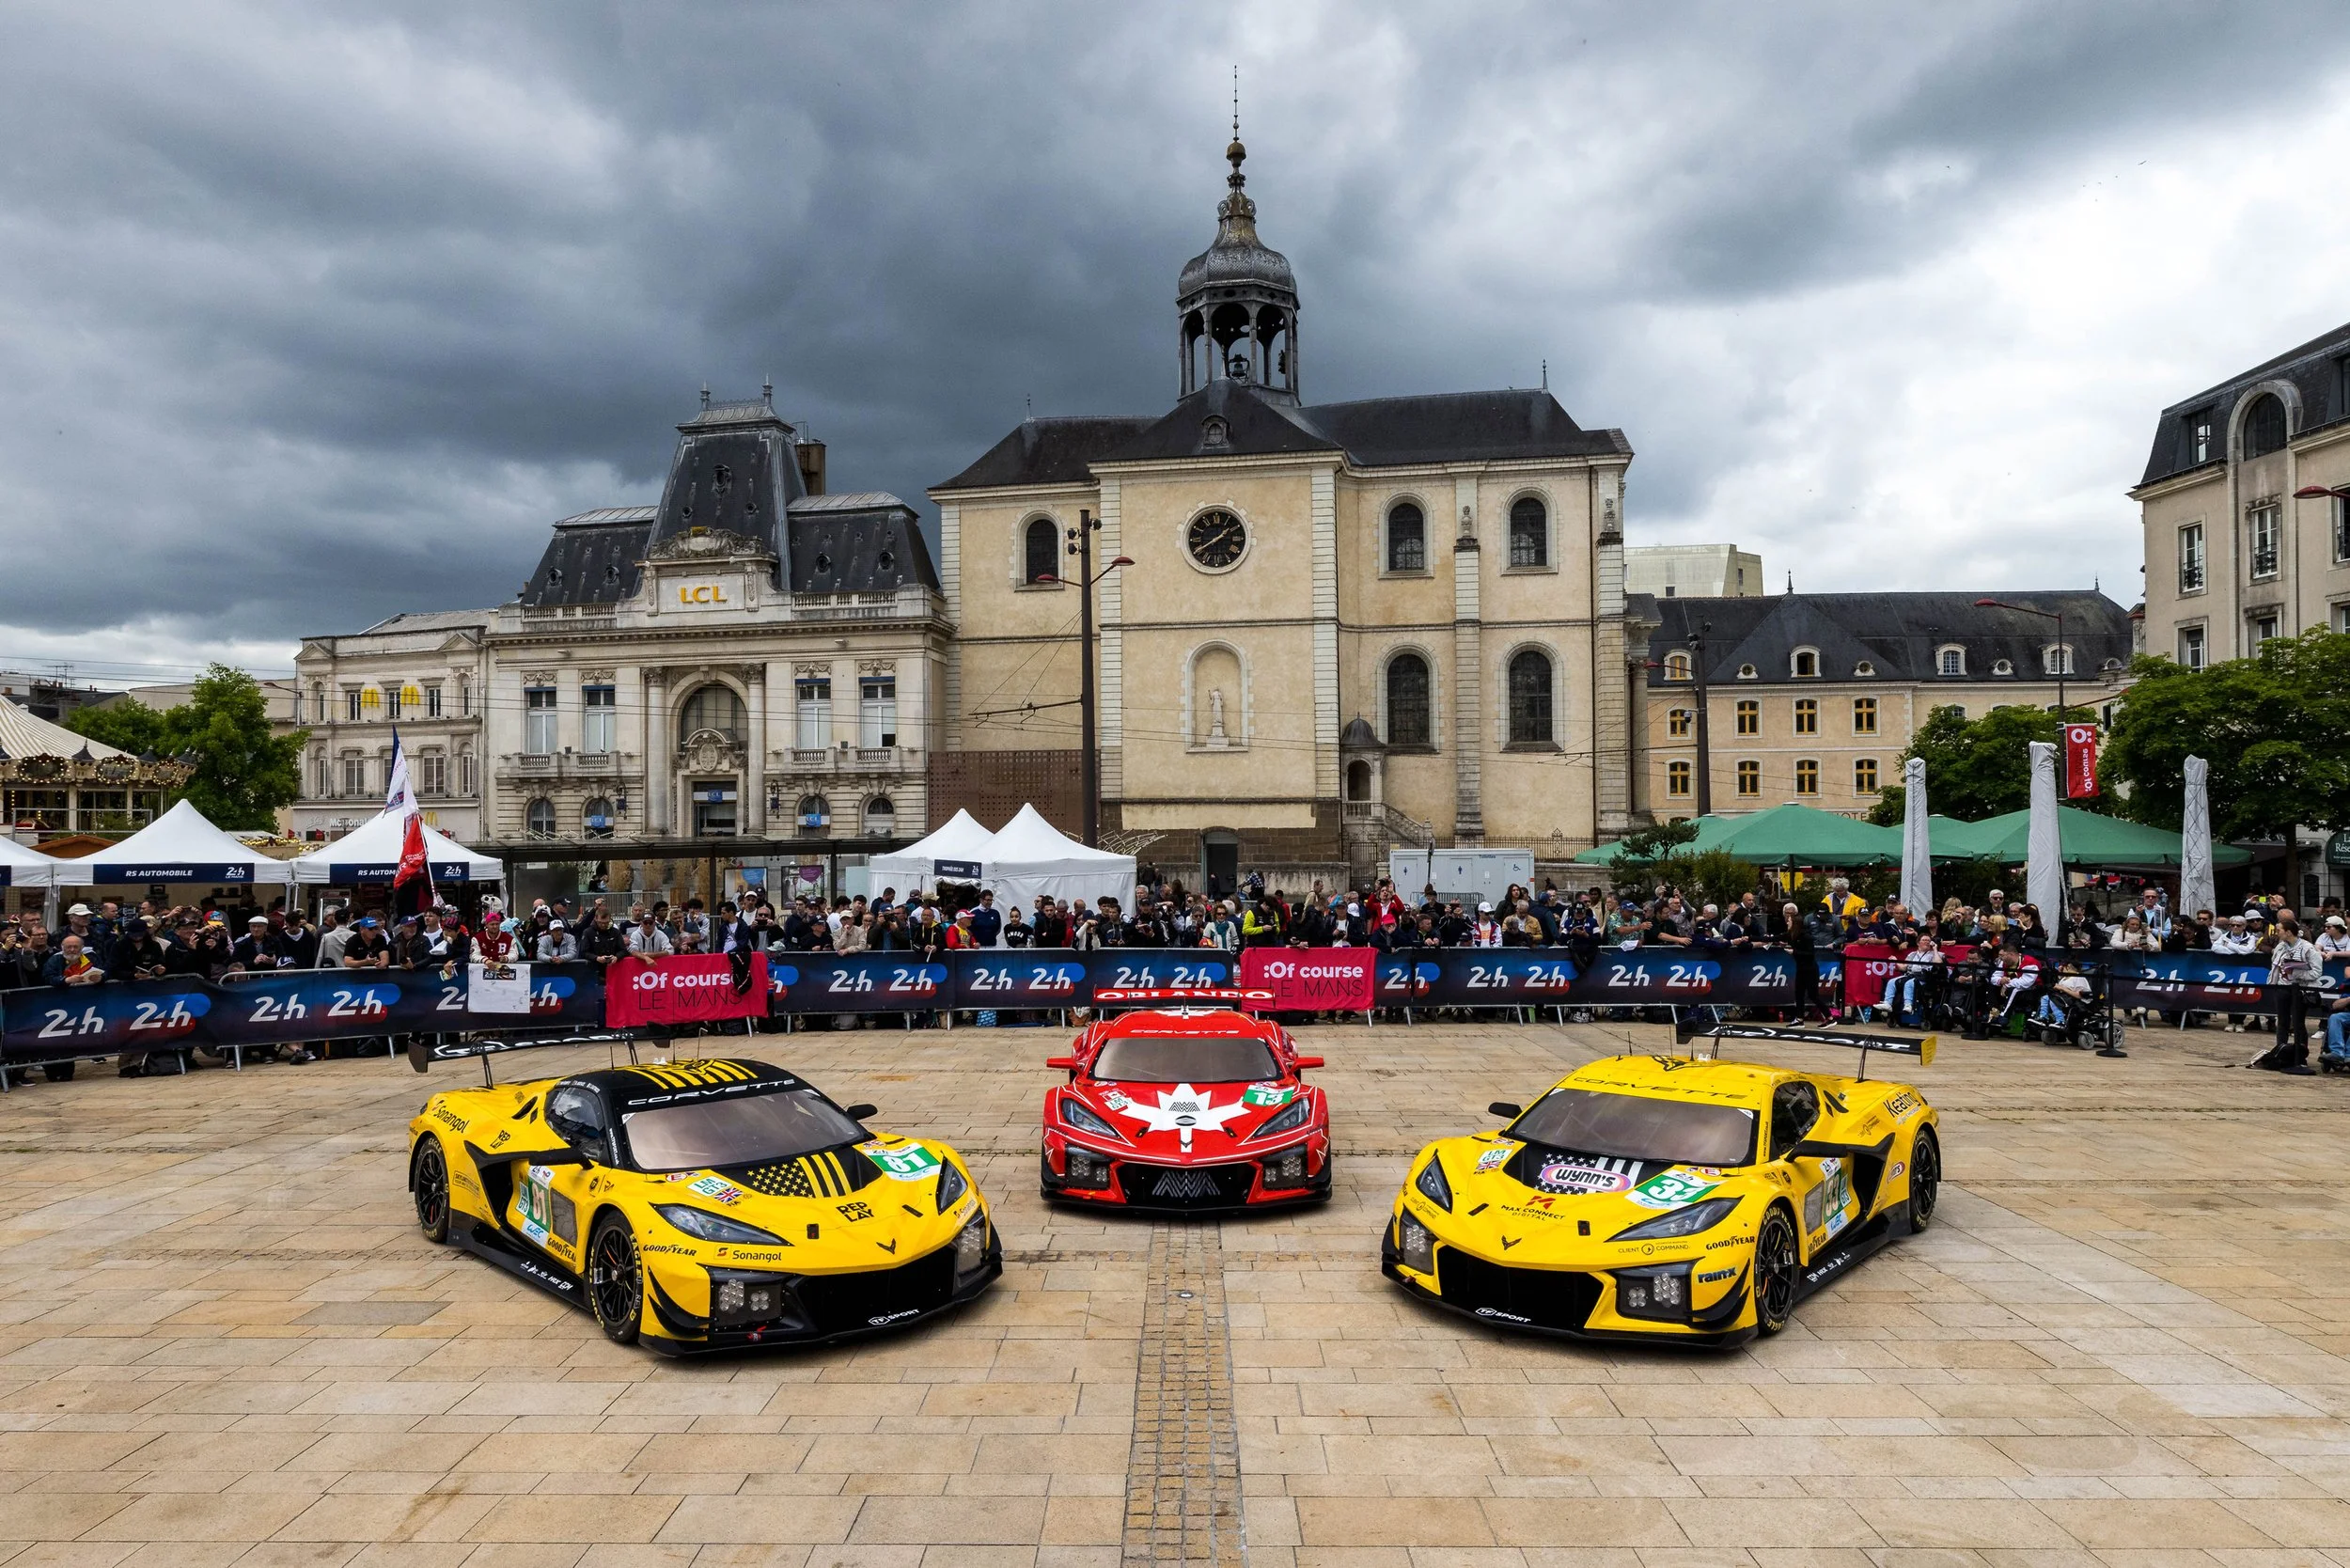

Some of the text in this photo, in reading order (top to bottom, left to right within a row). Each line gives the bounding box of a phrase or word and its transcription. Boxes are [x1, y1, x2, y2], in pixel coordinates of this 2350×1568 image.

[681, 586, 728, 604] LCL
[498, 943, 507, 954] B
[673, 972, 735, 987] cours
[829, 970, 872, 992] 24h
[889, 968, 932, 992] 24h
[970, 968, 1013, 991] 24h
[1029, 967, 1071, 990] 24h
[1114, 966, 1155, 988] 24h
[1169, 966, 1212, 988] 24h
[1300, 965, 1363, 979] course
[1467, 966, 1509, 988] 24h
[1525, 966, 1566, 987] 24h
[1608, 964, 1650, 987] 24h
[1667, 965, 1708, 987] 24h
[1749, 964, 1787, 987] 24h
[1305, 980, 1363, 997] MANS
[249, 994, 306, 1022] 24h
[328, 989, 383, 1016] 24h
[638, 988, 743, 1011] LE MANS
[39, 1006, 105, 1038] 24h
[130, 1000, 192, 1030] 24h
[628, 1078, 796, 1105] CORVETTE
[1254, 1091, 1284, 1106] 13
[1574, 1076, 1748, 1100] CORVETTE
[1883, 1091, 1922, 1119] Keating
[433, 1105, 470, 1134] Sonangol
[883, 1152, 928, 1173] 81
[1481, 1154, 1506, 1163] GT3
[694, 1179, 716, 1189] LM
[702, 1183, 728, 1195] GT3
[532, 1184, 547, 1225] 81
[836, 1201, 869, 1215] REP
[1501, 1204, 1566, 1220] MAX CONNECT
[843, 1208, 876, 1223] LAY
[1512, 1212, 1546, 1221] DIGITAL
[526, 1224, 544, 1239] WEC
[643, 1243, 697, 1258] GOODYEAR
[1705, 1235, 1756, 1250] GOODYEAR
[731, 1249, 782, 1263] Sonangol
[887, 1309, 920, 1321] SPORT
[1496, 1312, 1531, 1324] SPORT
